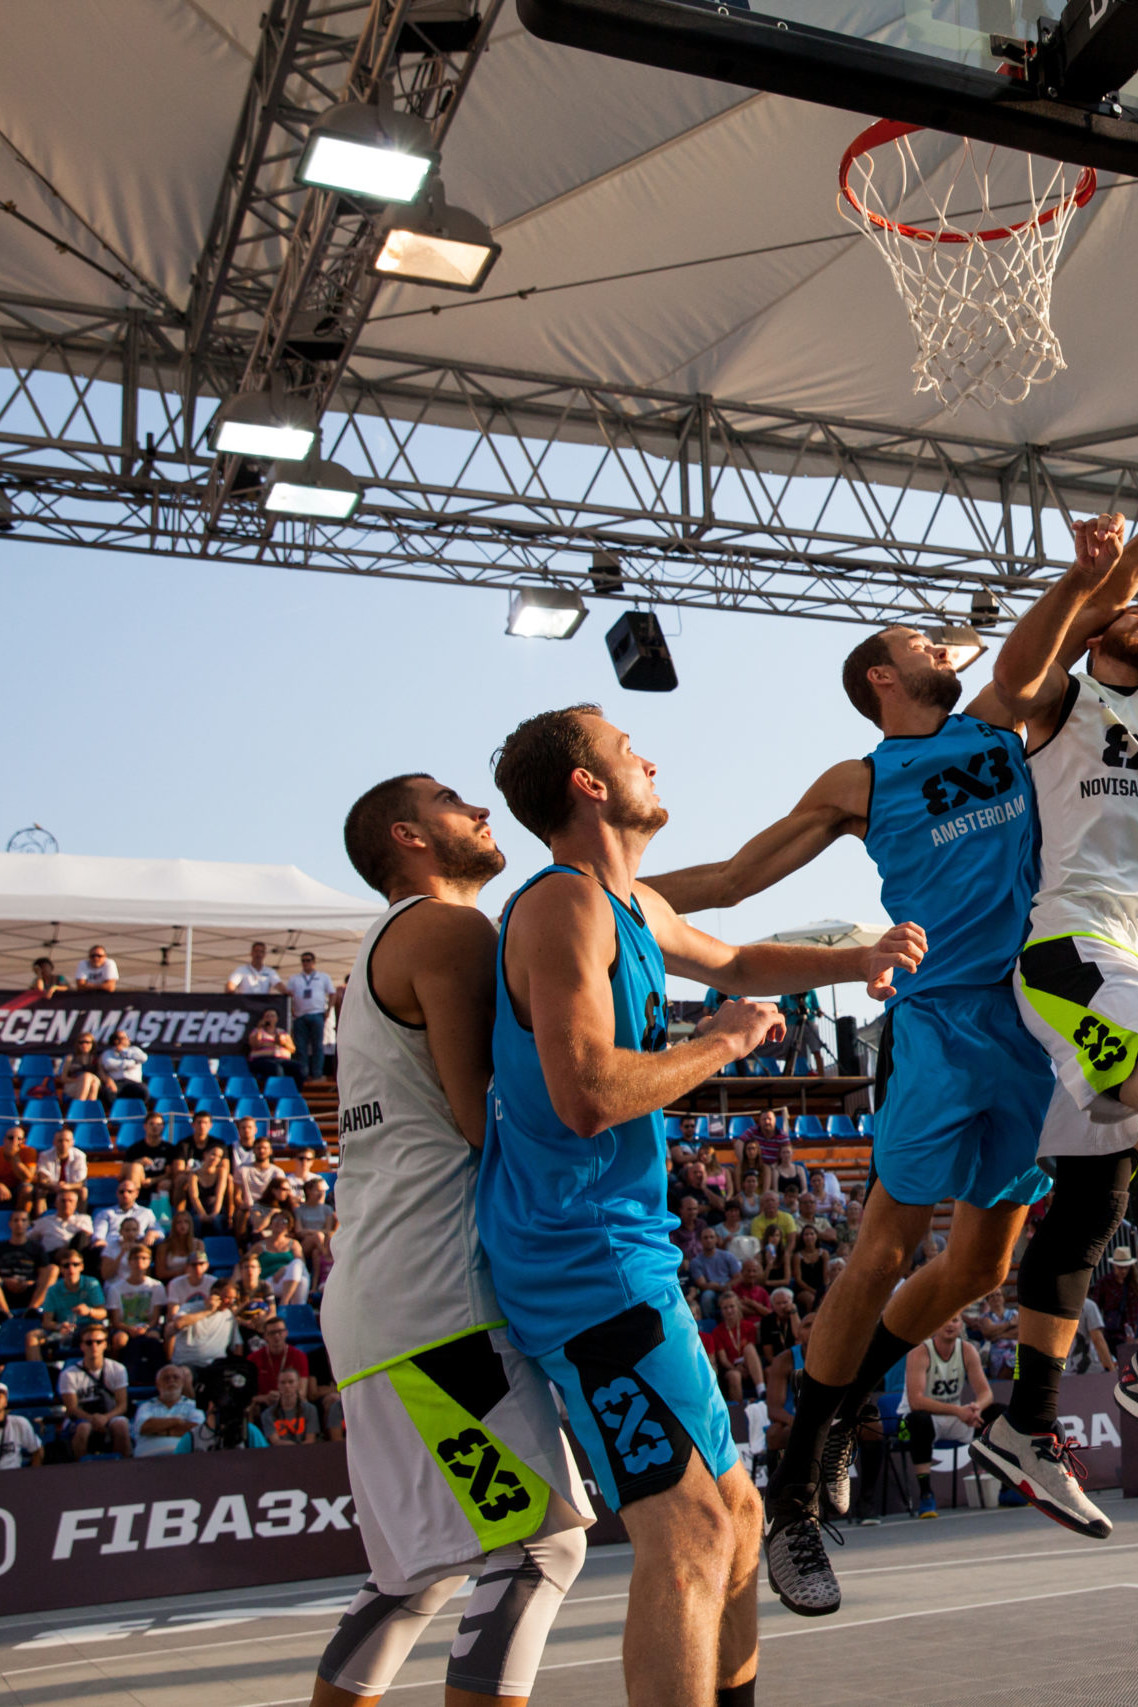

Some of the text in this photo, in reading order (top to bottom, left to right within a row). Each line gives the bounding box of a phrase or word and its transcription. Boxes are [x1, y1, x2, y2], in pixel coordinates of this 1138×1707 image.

[930, 794, 1026, 847] AMSTERDAM
[81, 1009, 250, 1043] MASTERS
[339, 1101, 384, 1138] AHDA
[52, 1489, 360, 1560] FIBA3x
